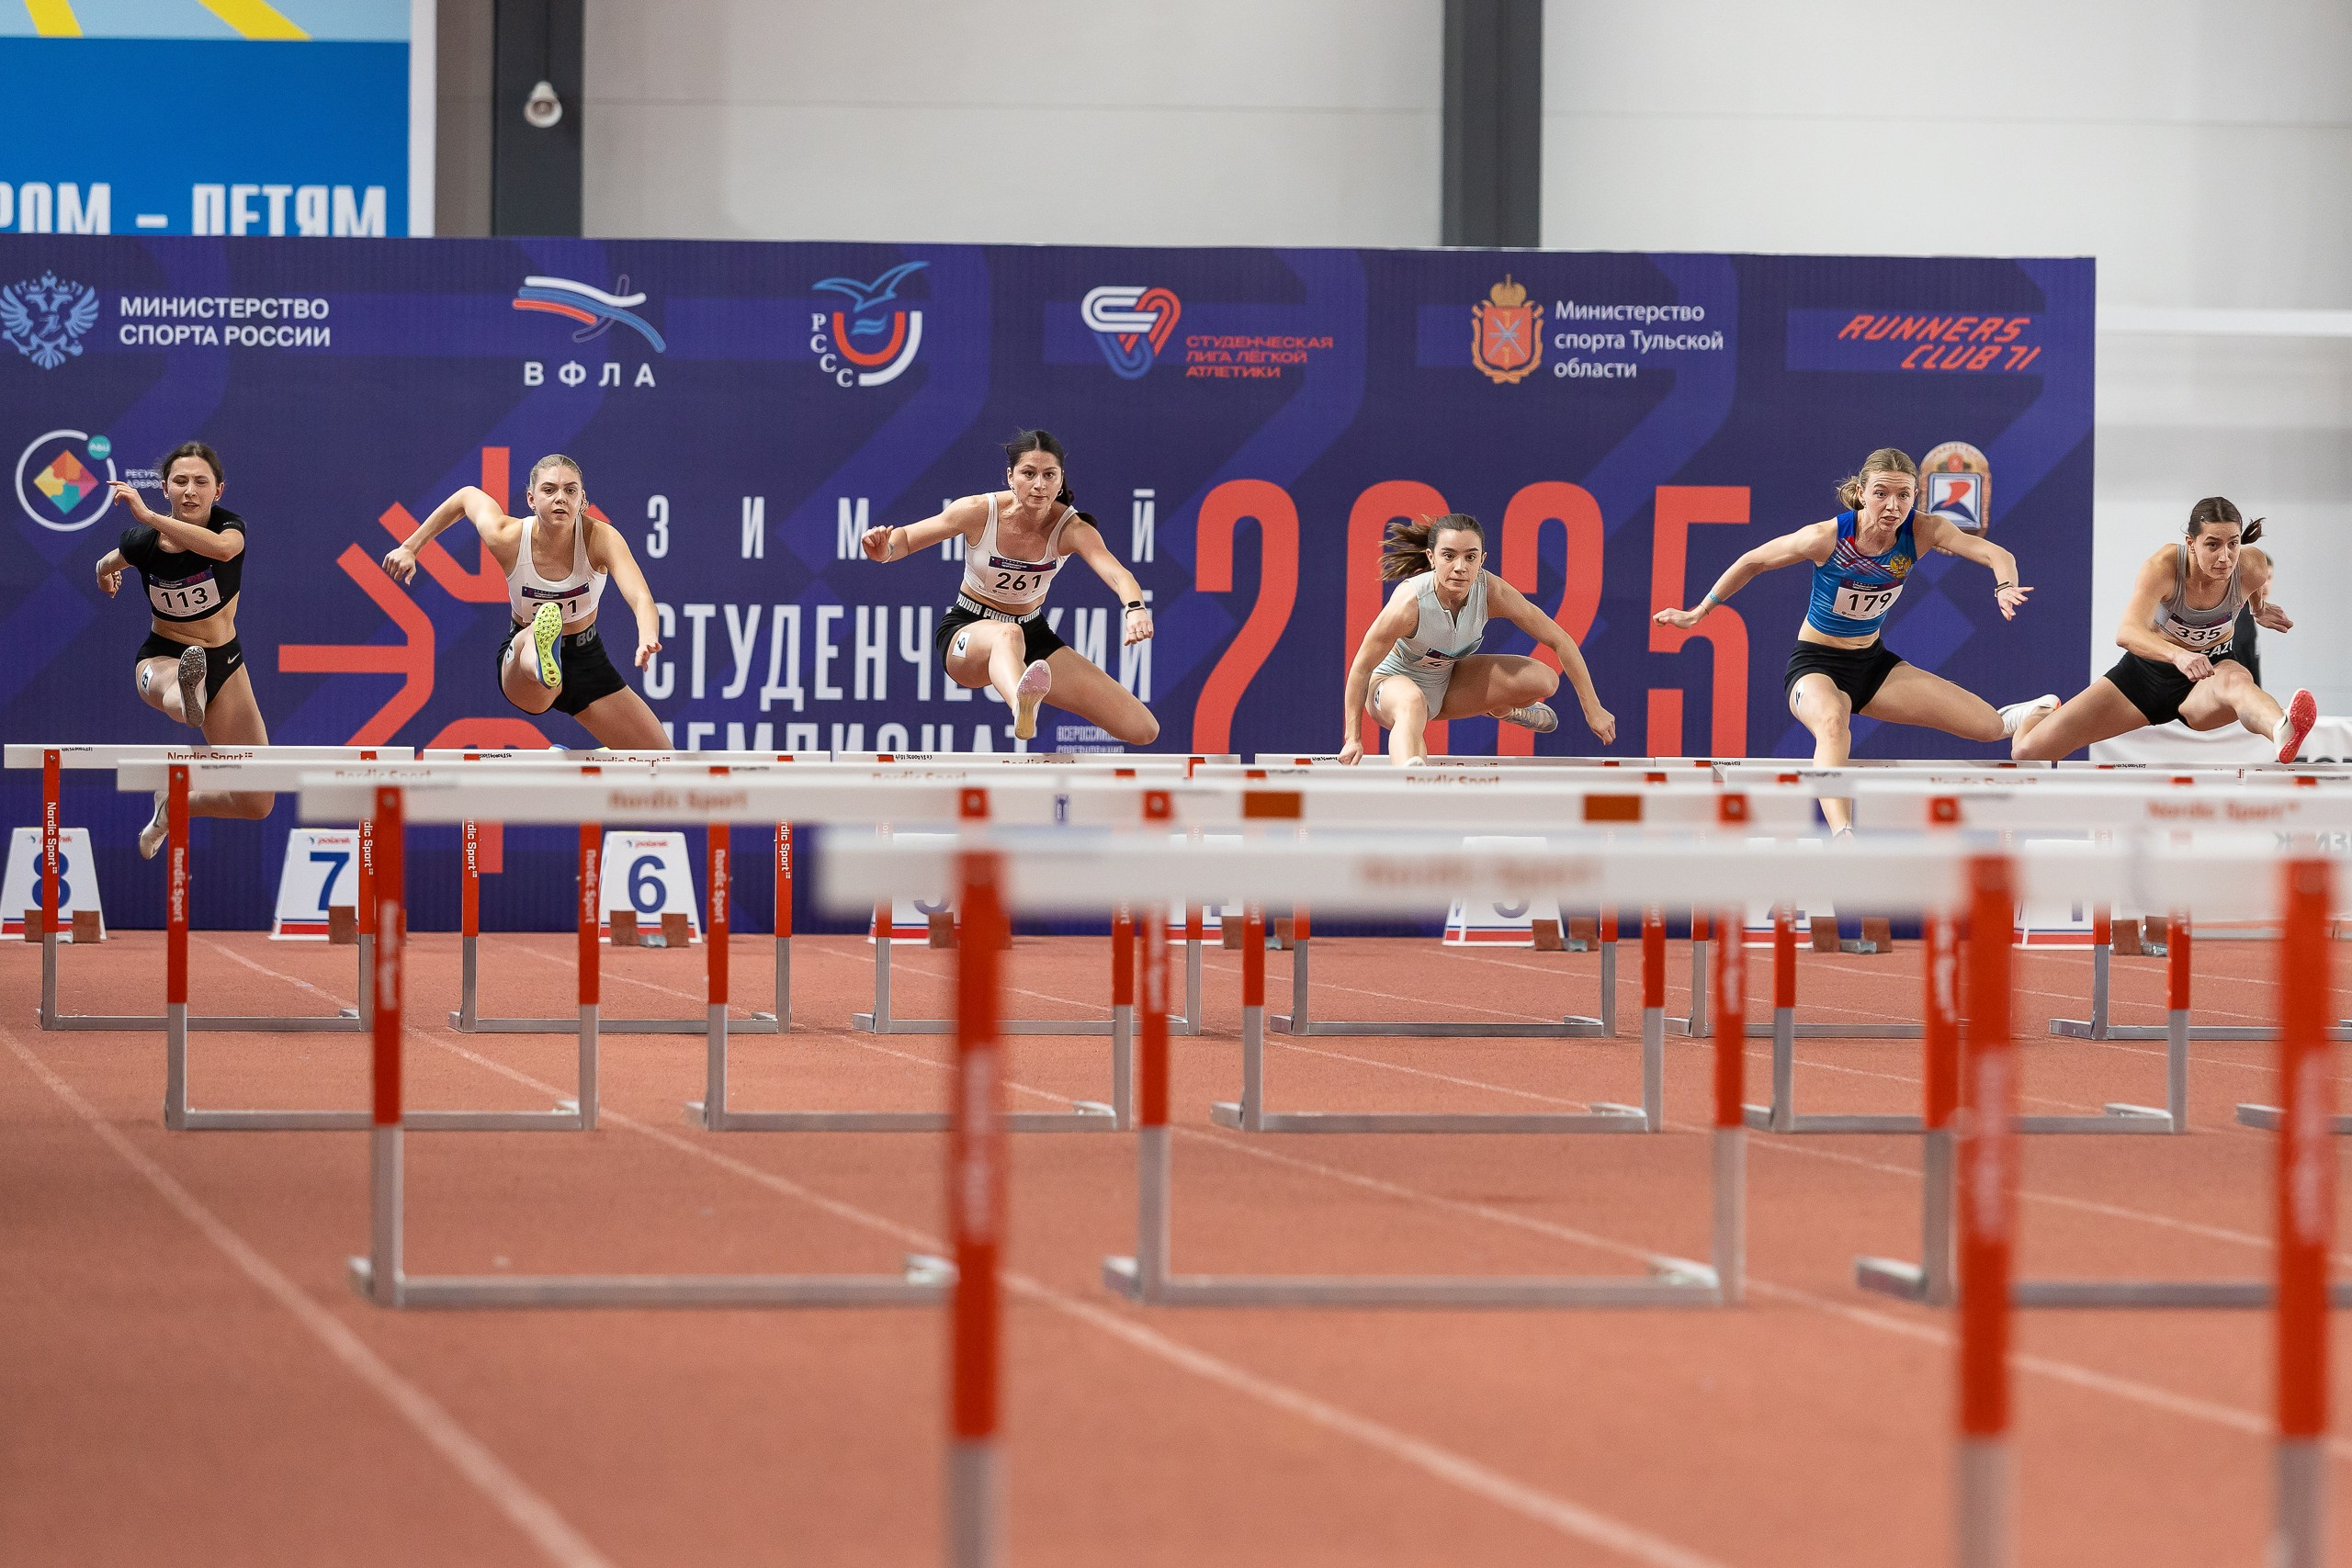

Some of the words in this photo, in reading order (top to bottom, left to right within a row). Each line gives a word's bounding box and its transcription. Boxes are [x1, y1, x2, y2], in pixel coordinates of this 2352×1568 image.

[119, 296, 330, 320] МИНИСТЕРСТВО
[1555, 300, 1705, 325] Министерство
[119, 324, 219, 347] СПОРТА
[223, 325, 331, 347] РОССИИ
[1838, 314, 2030, 342] RUNNERS
[1185, 335, 1334, 349] СТУДЕНЧЕСКАЯ
[1554, 333, 1625, 354] спорта
[1630, 330, 1724, 355] Тульской
[1185, 350, 1232, 363] ЛИГА
[1553, 357, 1637, 378] области
[1901, 344, 2003, 370] CLUB
[524, 360, 656, 387] ВФЛА
[1185, 365, 1281, 378] АТЛЕТИКИ
[995, 572, 1042, 591] 261
[161, 587, 209, 609] 113
[1848, 592, 1893, 613] 179
[2175, 626, 2222, 641] 335
[47, 802, 57, 836] Nordic
[364, 818, 373, 837] rdic
[467, 820, 477, 840] rdic
[781, 820, 791, 840] rdic
[46, 838, 57, 865] Sport
[362, 839, 373, 868] Sport
[466, 841, 477, 871] Sport
[779, 842, 790, 871] Sport
[32, 851, 72, 908] 8
[310, 852, 350, 910] 7
[628, 855, 667, 913] 6
